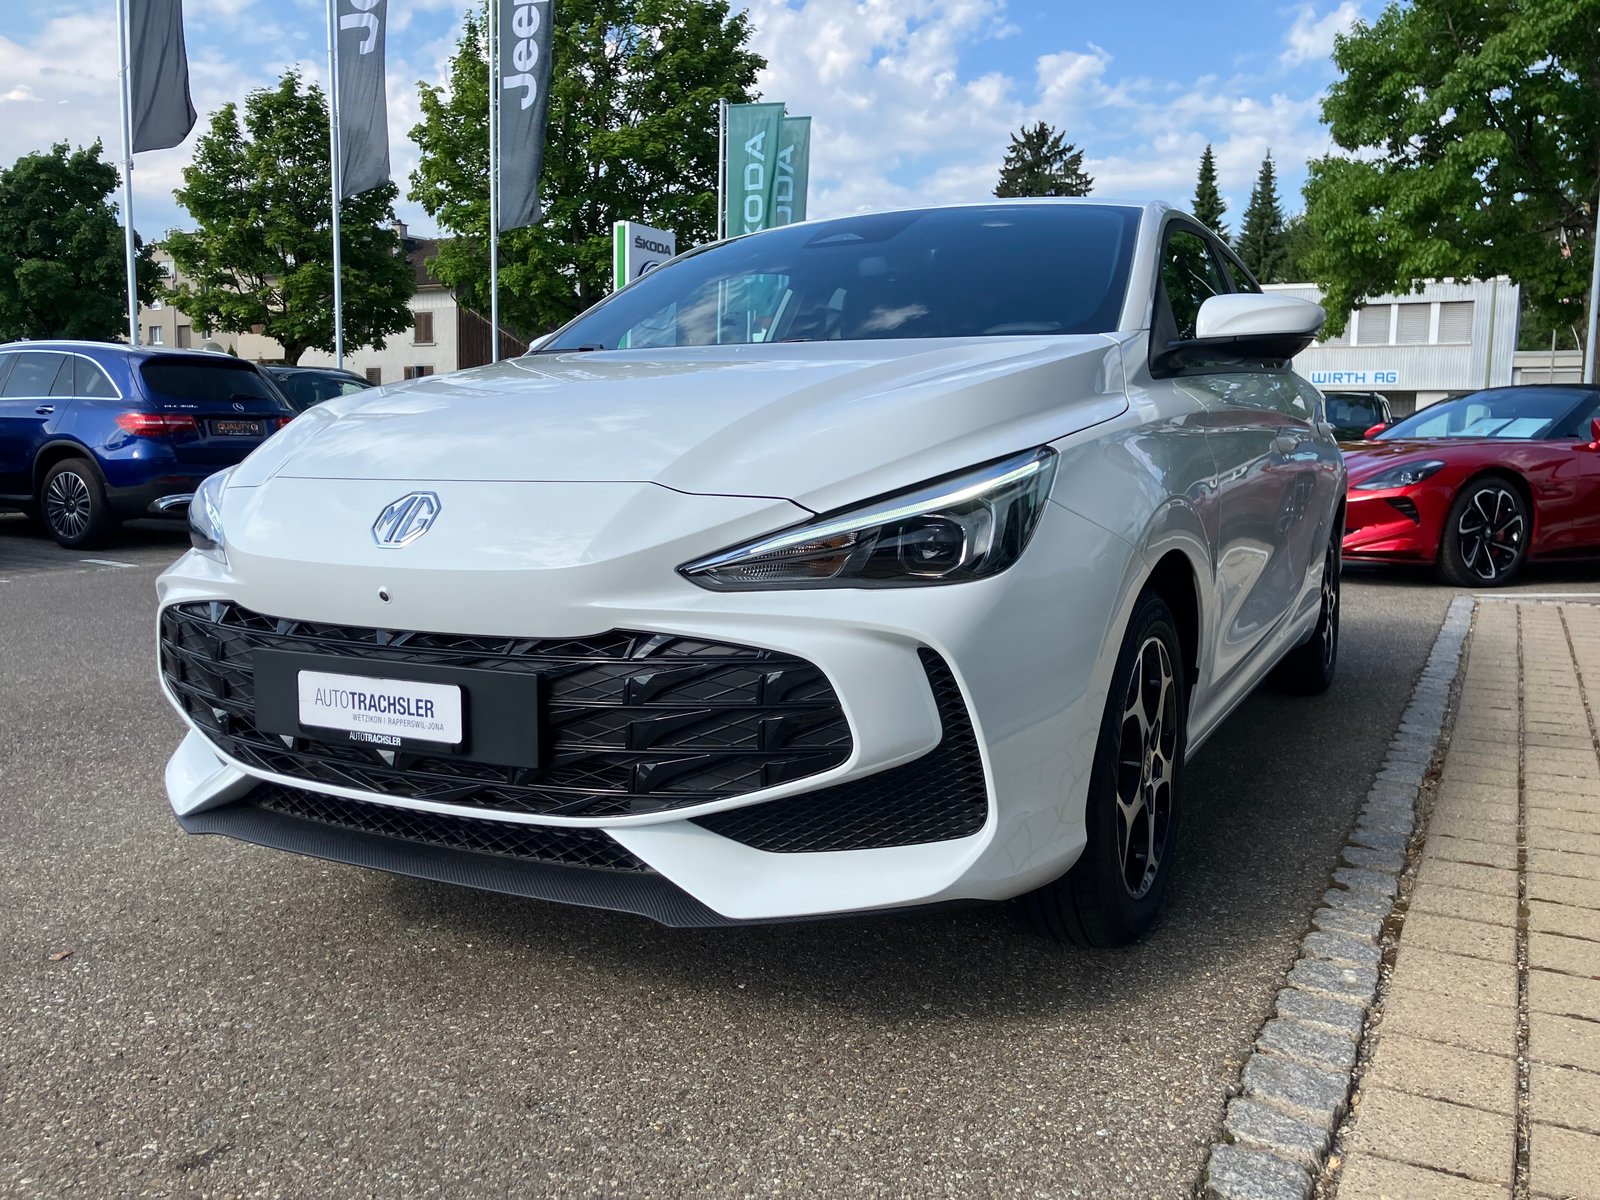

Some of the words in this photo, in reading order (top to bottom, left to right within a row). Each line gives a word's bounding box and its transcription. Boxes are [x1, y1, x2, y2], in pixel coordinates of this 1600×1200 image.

[503, 0, 549, 110] Jee
[635, 235, 672, 256] ŠKODA
[1311, 372, 1366, 384] WIRTH
[1374, 371, 1397, 384] AG
[217, 422, 250, 431] QUALITY
[377, 496, 435, 543] MG
[352, 713, 383, 725] WETZIKON
[387, 717, 445, 732] RAPPERSWIL-JONA
[349, 731, 402, 746] AUTOTRACHSLER
